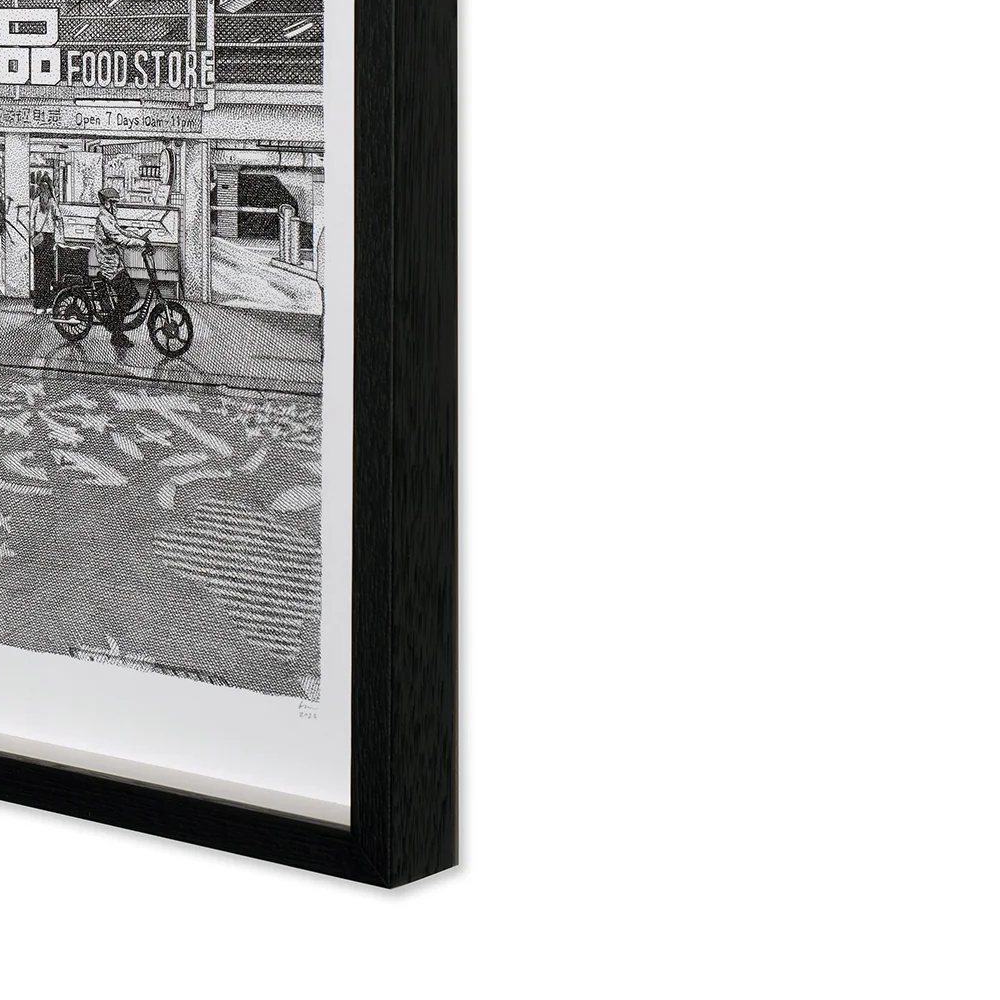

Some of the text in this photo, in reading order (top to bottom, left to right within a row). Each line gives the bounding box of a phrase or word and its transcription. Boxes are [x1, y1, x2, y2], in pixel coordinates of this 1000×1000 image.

[67, 50, 128, 88] FOOD
[134, 50, 214, 90] STORE
[75, 112, 101, 129] Open
[105, 111, 112, 126] 7
[116, 112, 140, 130] Days
